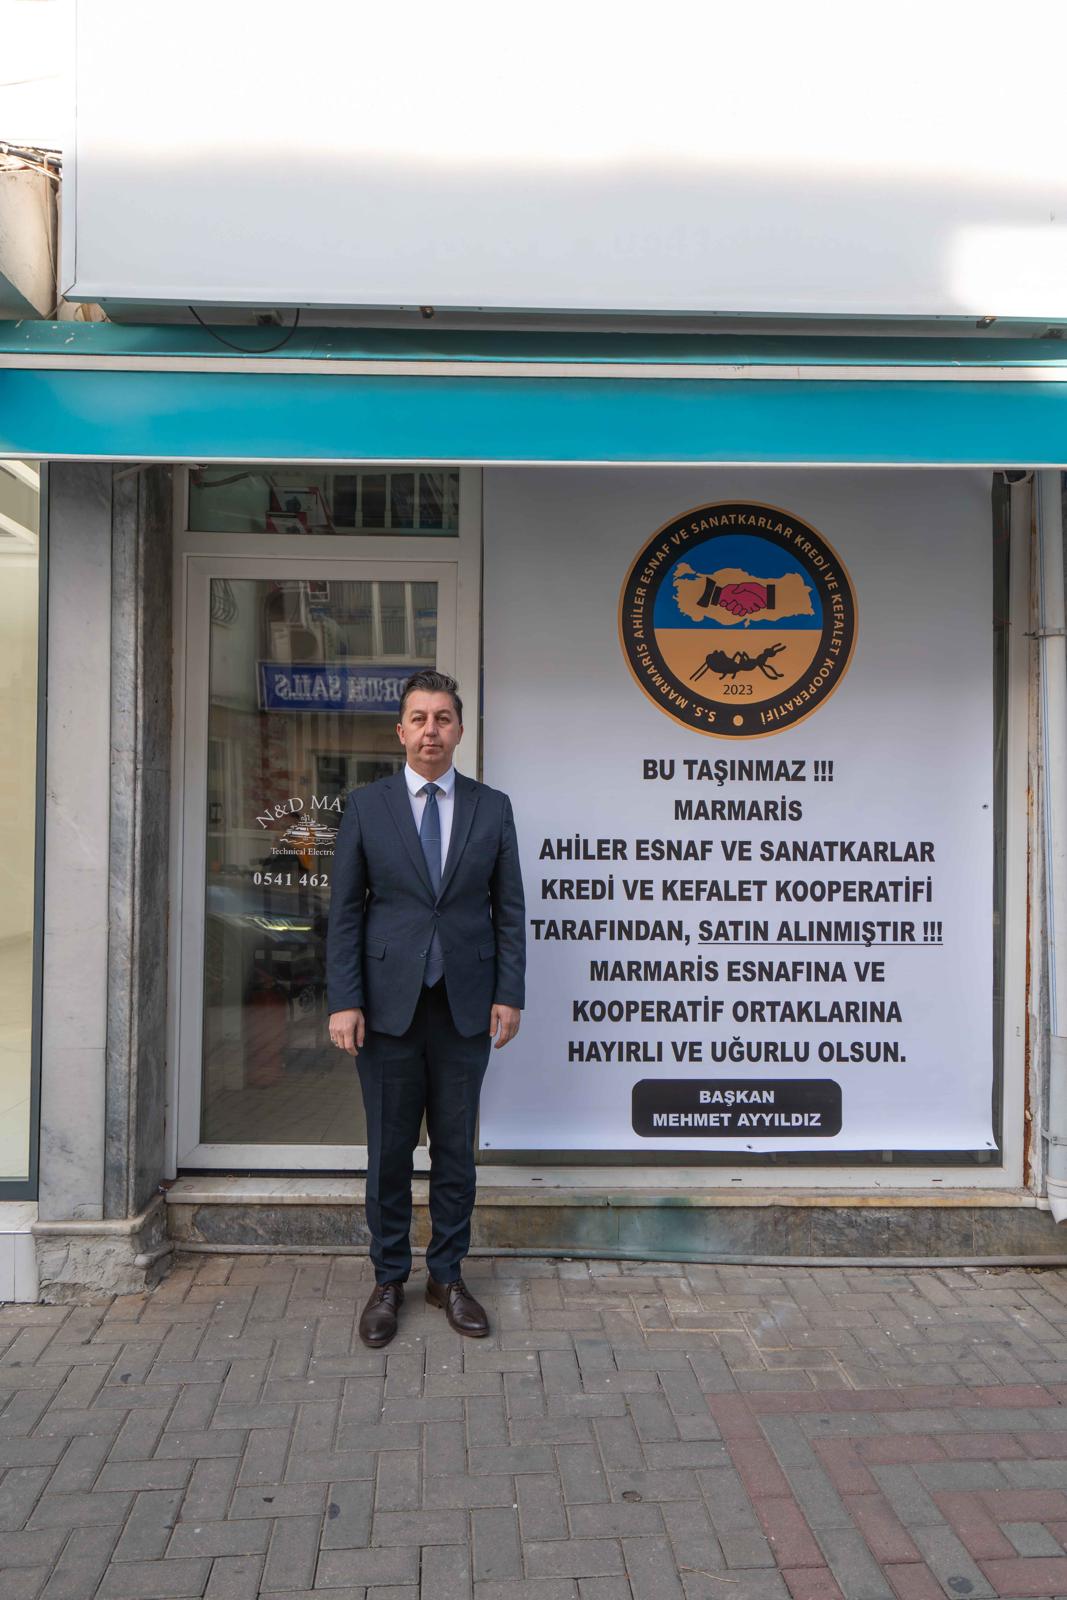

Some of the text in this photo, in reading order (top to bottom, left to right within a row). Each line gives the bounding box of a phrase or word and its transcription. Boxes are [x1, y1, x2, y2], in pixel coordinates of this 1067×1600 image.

[630, 514, 845, 725] S.S. MARMARİS AHİLER ESNAF VE SANATKARLAR KREDİ VE KEFALET KOOPERATİFİ
[723, 684, 754, 695] 2023
[644, 759, 834, 786] BU TAŞINMAZ !!!
[256, 797, 304, 829] N&D
[674, 795, 803, 822] MARMARİS
[270, 847, 306, 856] Technical
[539, 833, 936, 862] AHİLER ESNAF VE SANATKARLAR
[253, 872, 329, 887] 0541 462
[541, 874, 932, 902] KREDİ VE KEFALET KOOPERATİFİ
[530, 919, 943, 947] TARAFINDAN, SATIN ALINMIŞTIR !!!
[589, 954, 885, 982] MARMARİS ESNAFINA VE
[572, 995, 903, 1023] KOOPERATİF ORTAKLARINA
[568, 1036, 906, 1063] HAYIRLI VE UĞURLU OLSUN.
[699, 1090, 775, 1107] BAŞKAN
[653, 1112, 822, 1127] MEHMET AYYILDIZ
